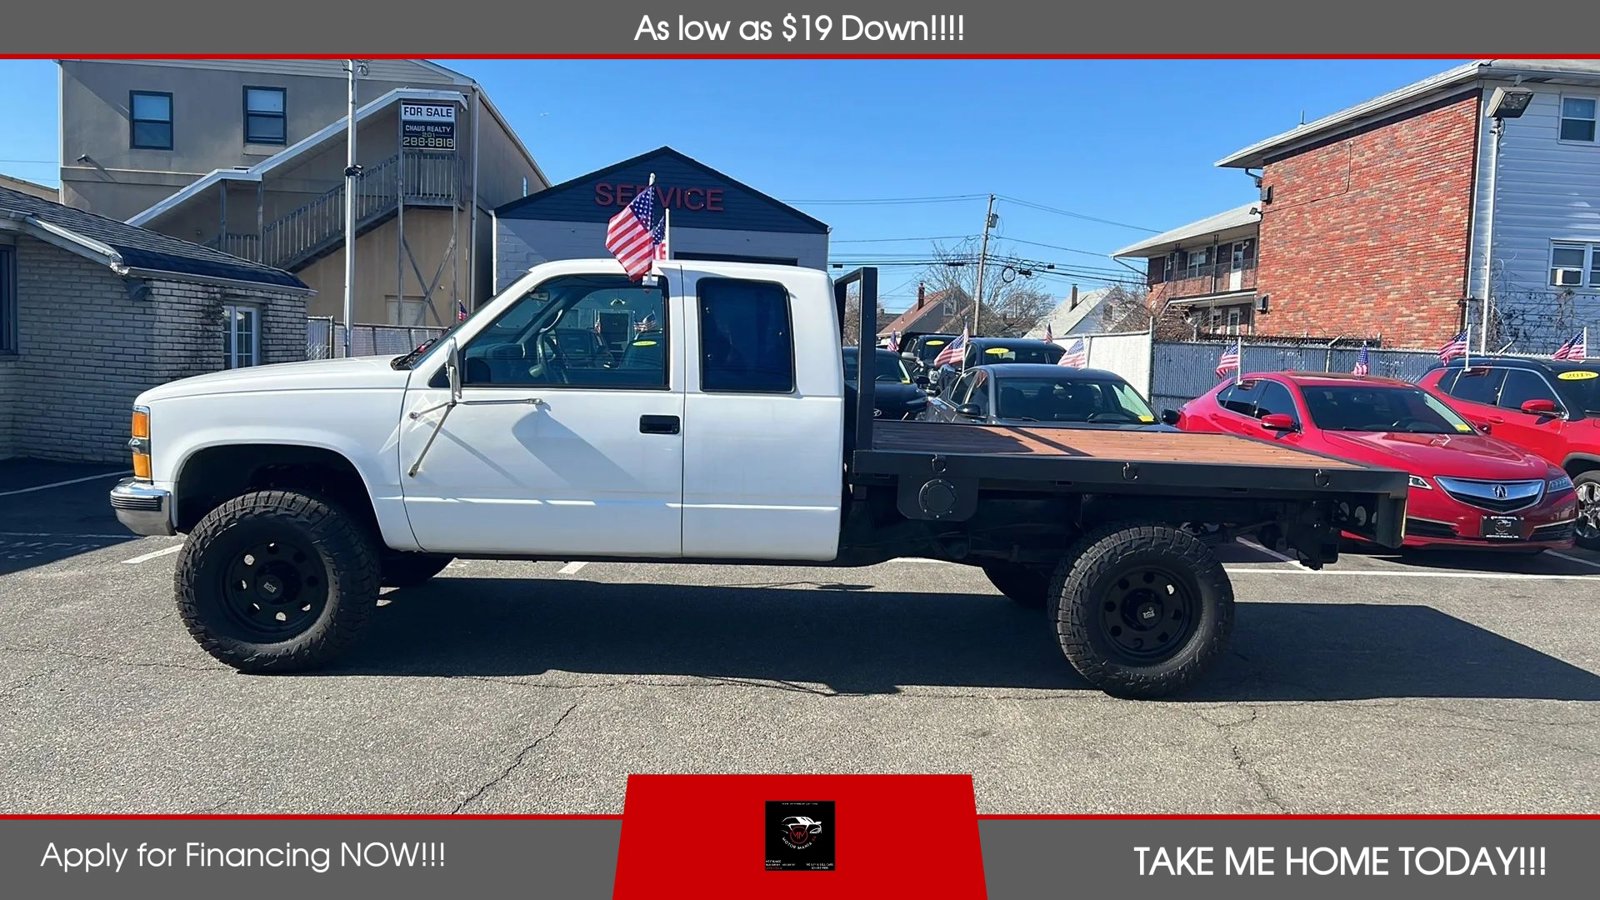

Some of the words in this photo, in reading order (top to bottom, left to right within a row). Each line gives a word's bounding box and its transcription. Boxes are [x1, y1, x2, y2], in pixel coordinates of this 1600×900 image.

[404, 106, 423, 117] FOR
[426, 107, 453, 118] SALE
[426, 125, 451, 133] REALTY
[594, 182, 724, 212] SEVICE
